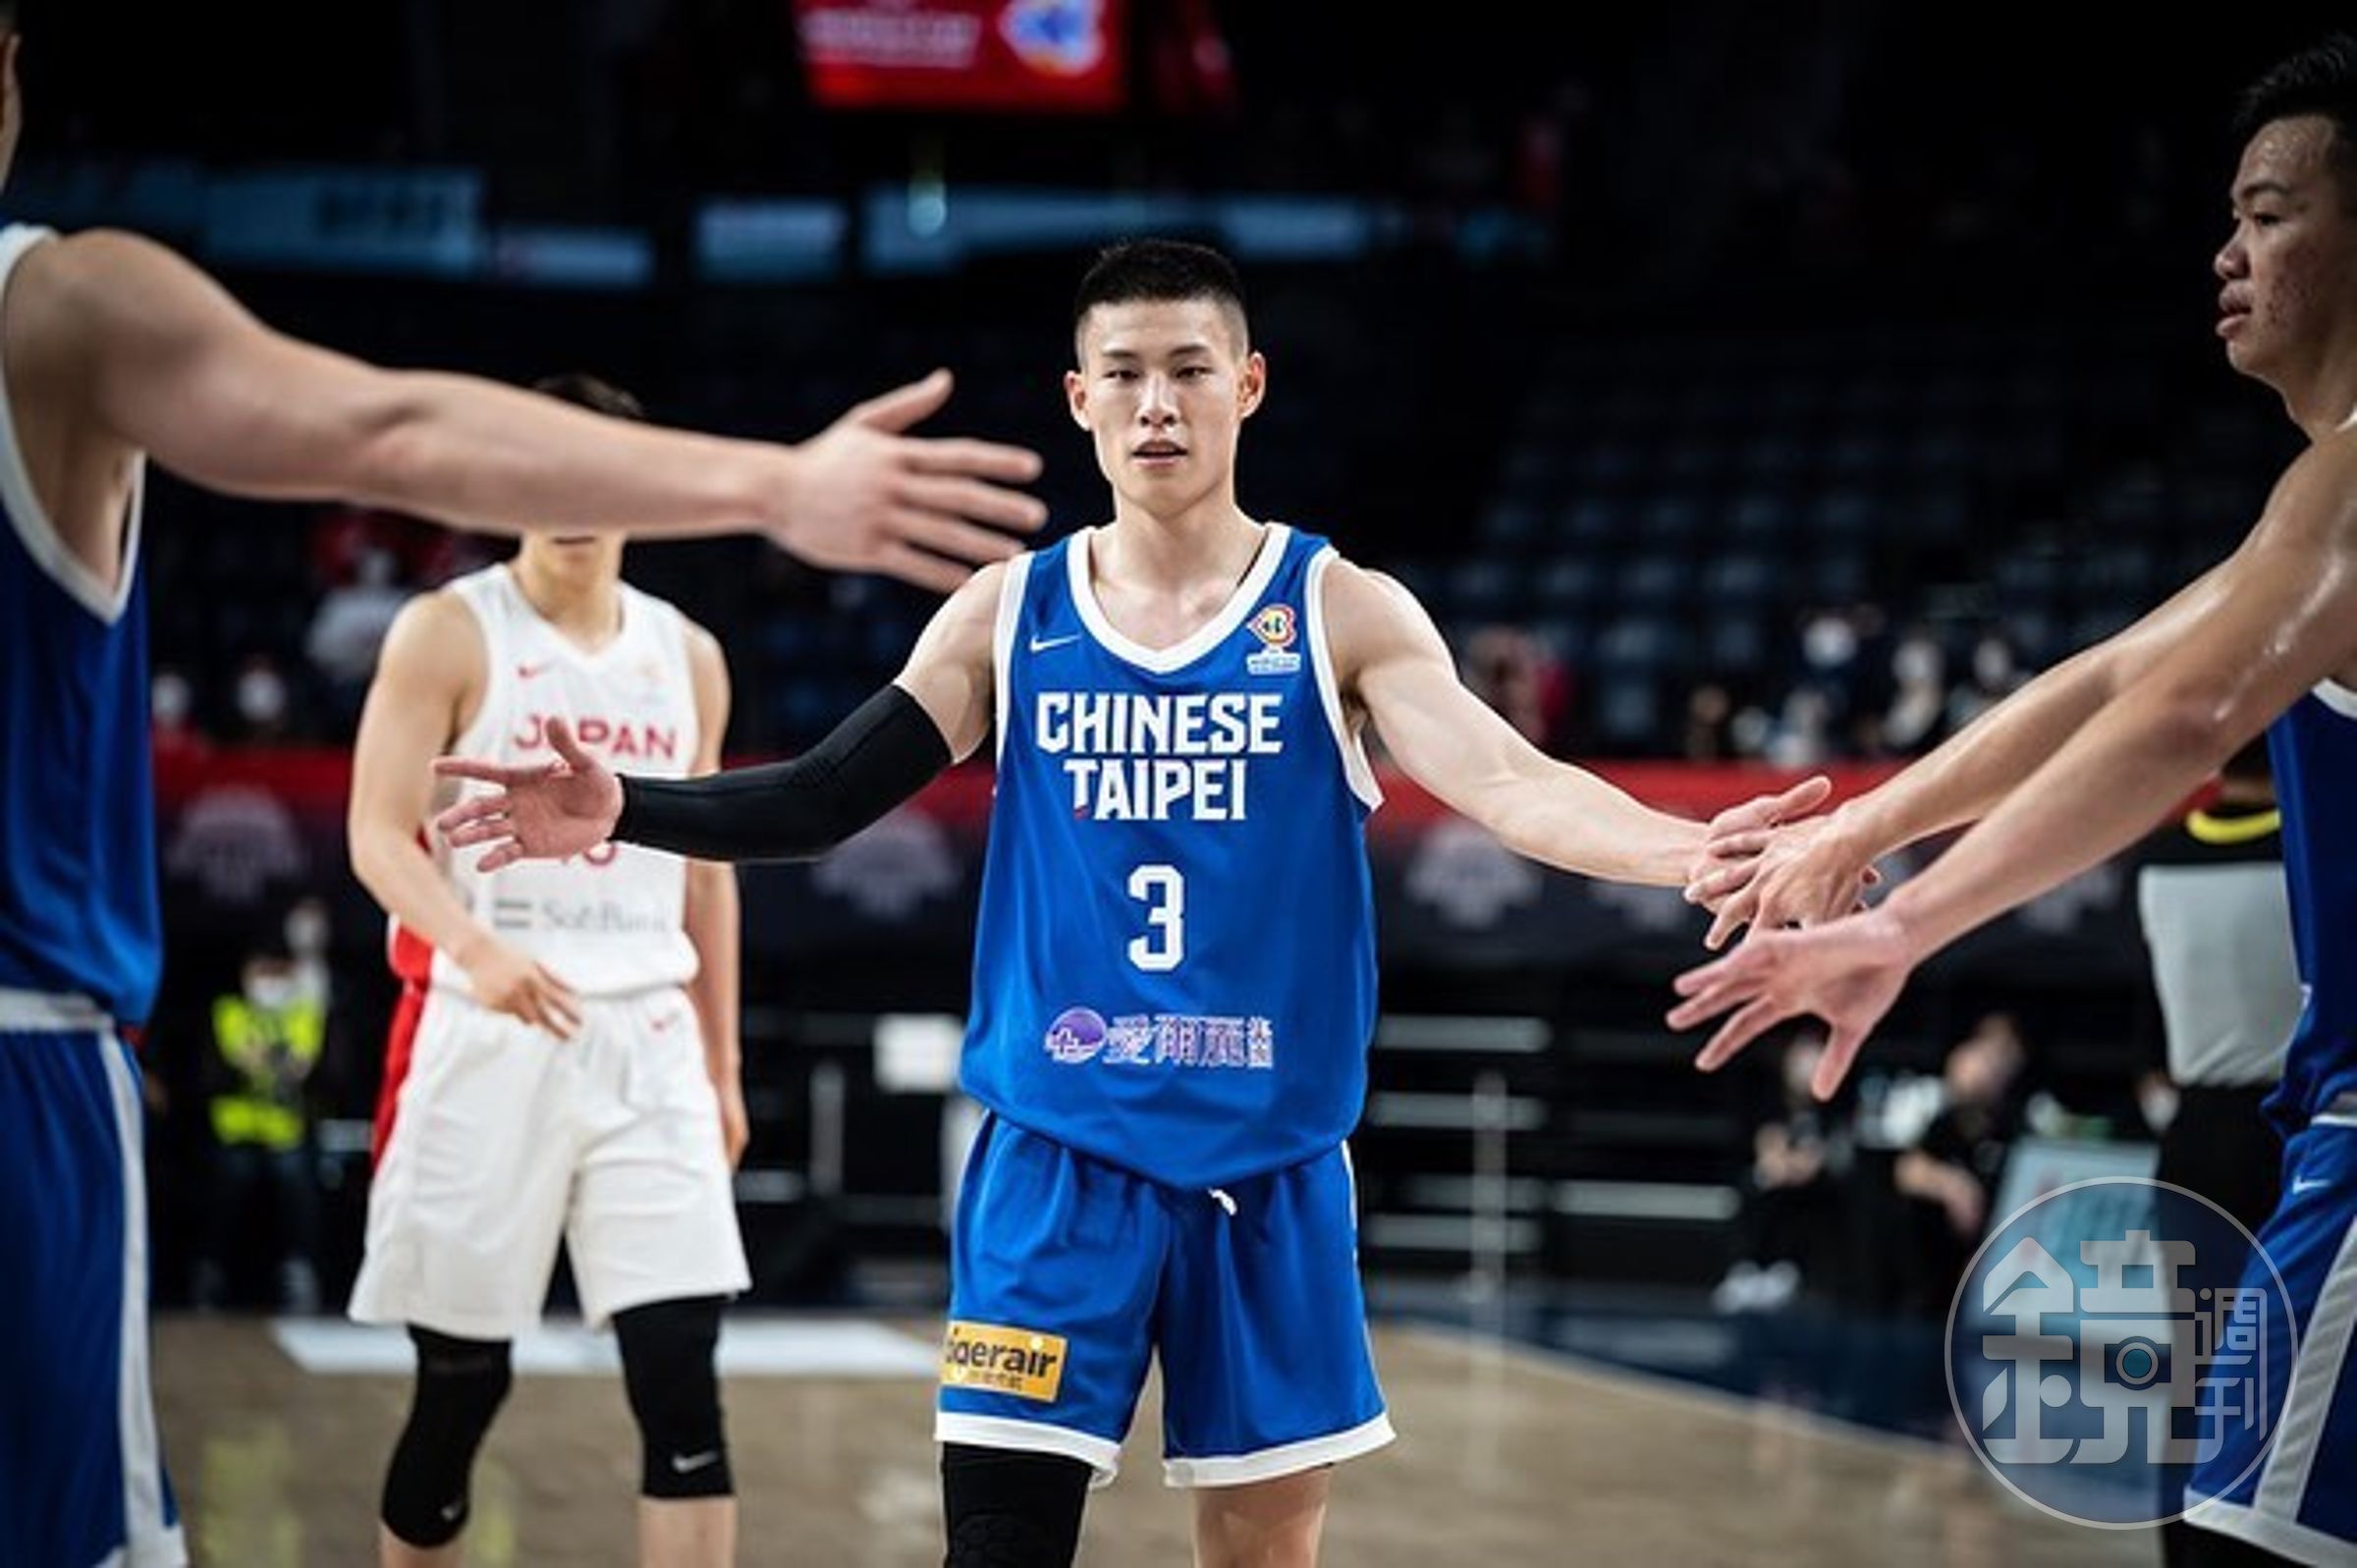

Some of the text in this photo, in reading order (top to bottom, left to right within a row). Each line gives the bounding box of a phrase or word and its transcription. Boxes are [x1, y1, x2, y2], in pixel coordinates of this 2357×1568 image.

[514, 714, 678, 760] JPAN
[1036, 692, 1284, 754] CHINESE
[1063, 758, 1247, 821] TAIPEI
[1126, 864, 1185, 972] 3
